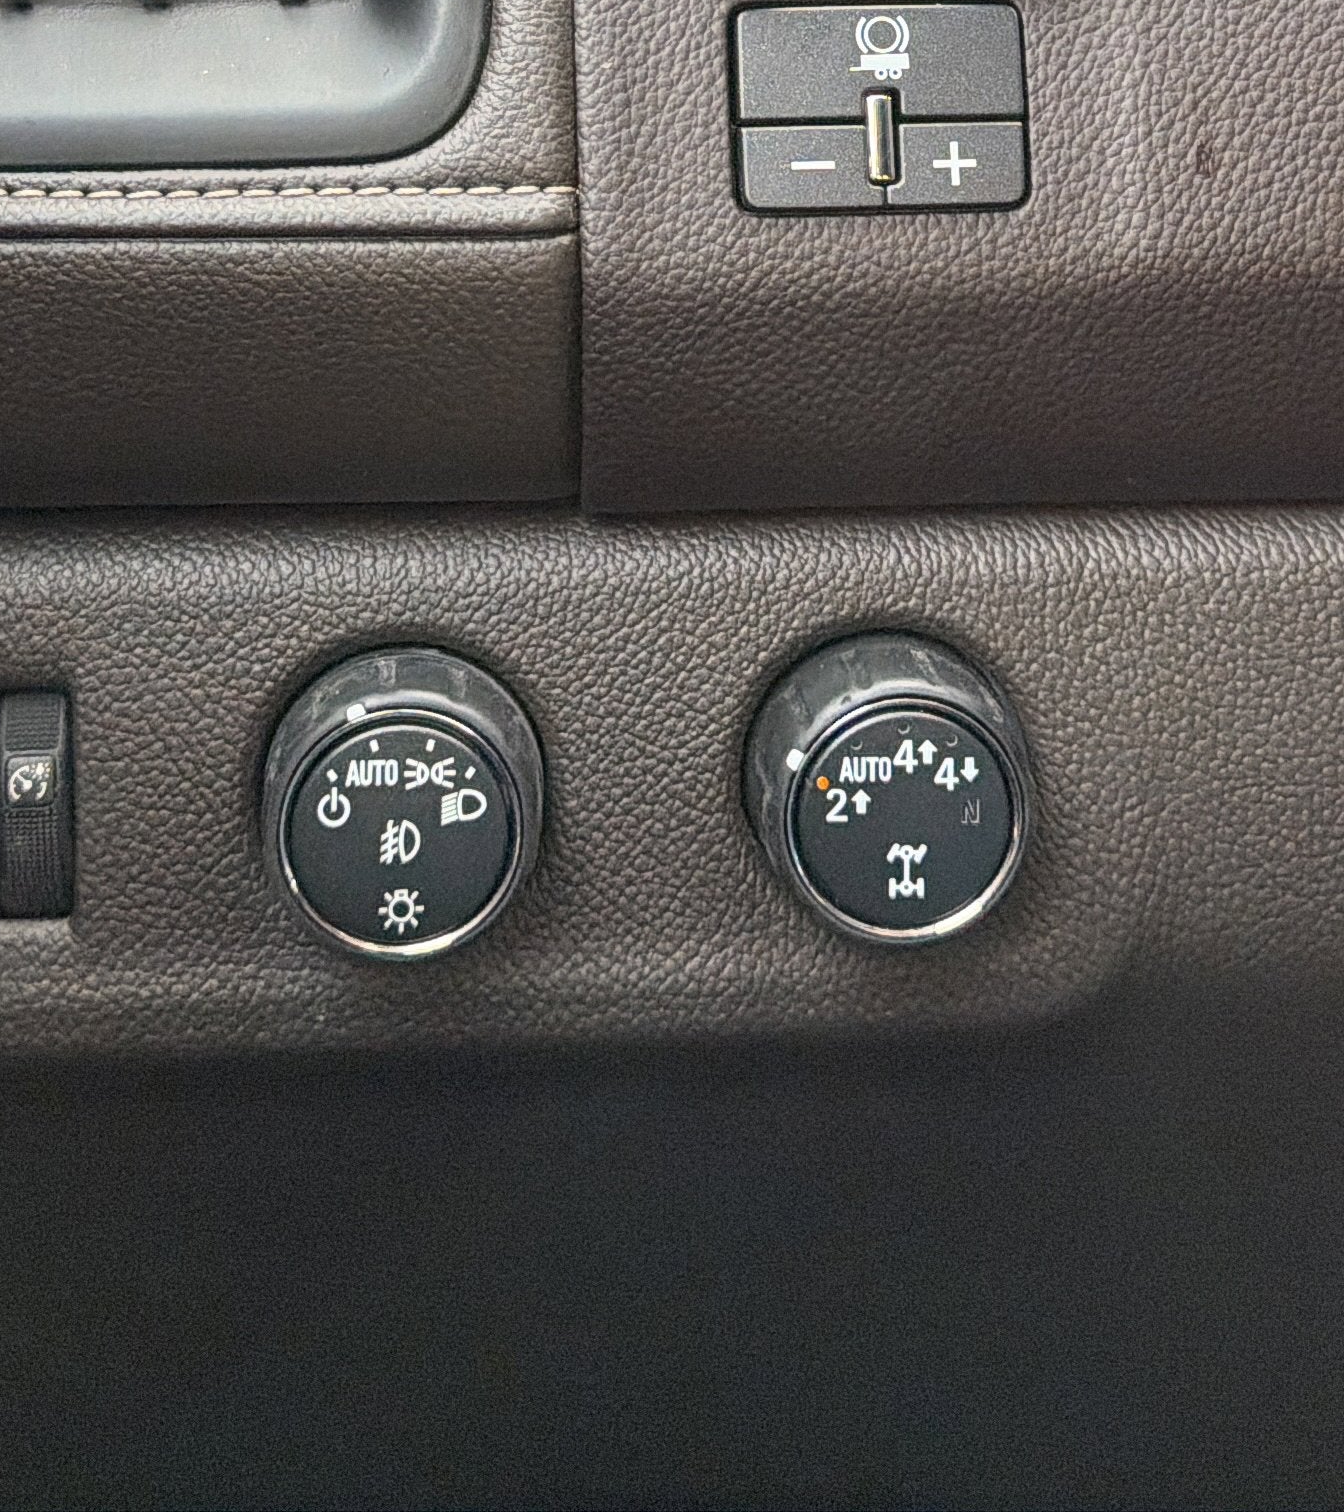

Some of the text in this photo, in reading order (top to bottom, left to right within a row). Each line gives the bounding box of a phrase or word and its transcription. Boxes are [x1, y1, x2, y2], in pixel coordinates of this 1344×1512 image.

[839, 756, 892, 784] AUTO
[893, 739, 919, 774] 4
[345, 759, 399, 788] AUTO
[934, 757, 960, 791] 4
[825, 788, 849, 823] 2
[961, 798, 981, 825] N
